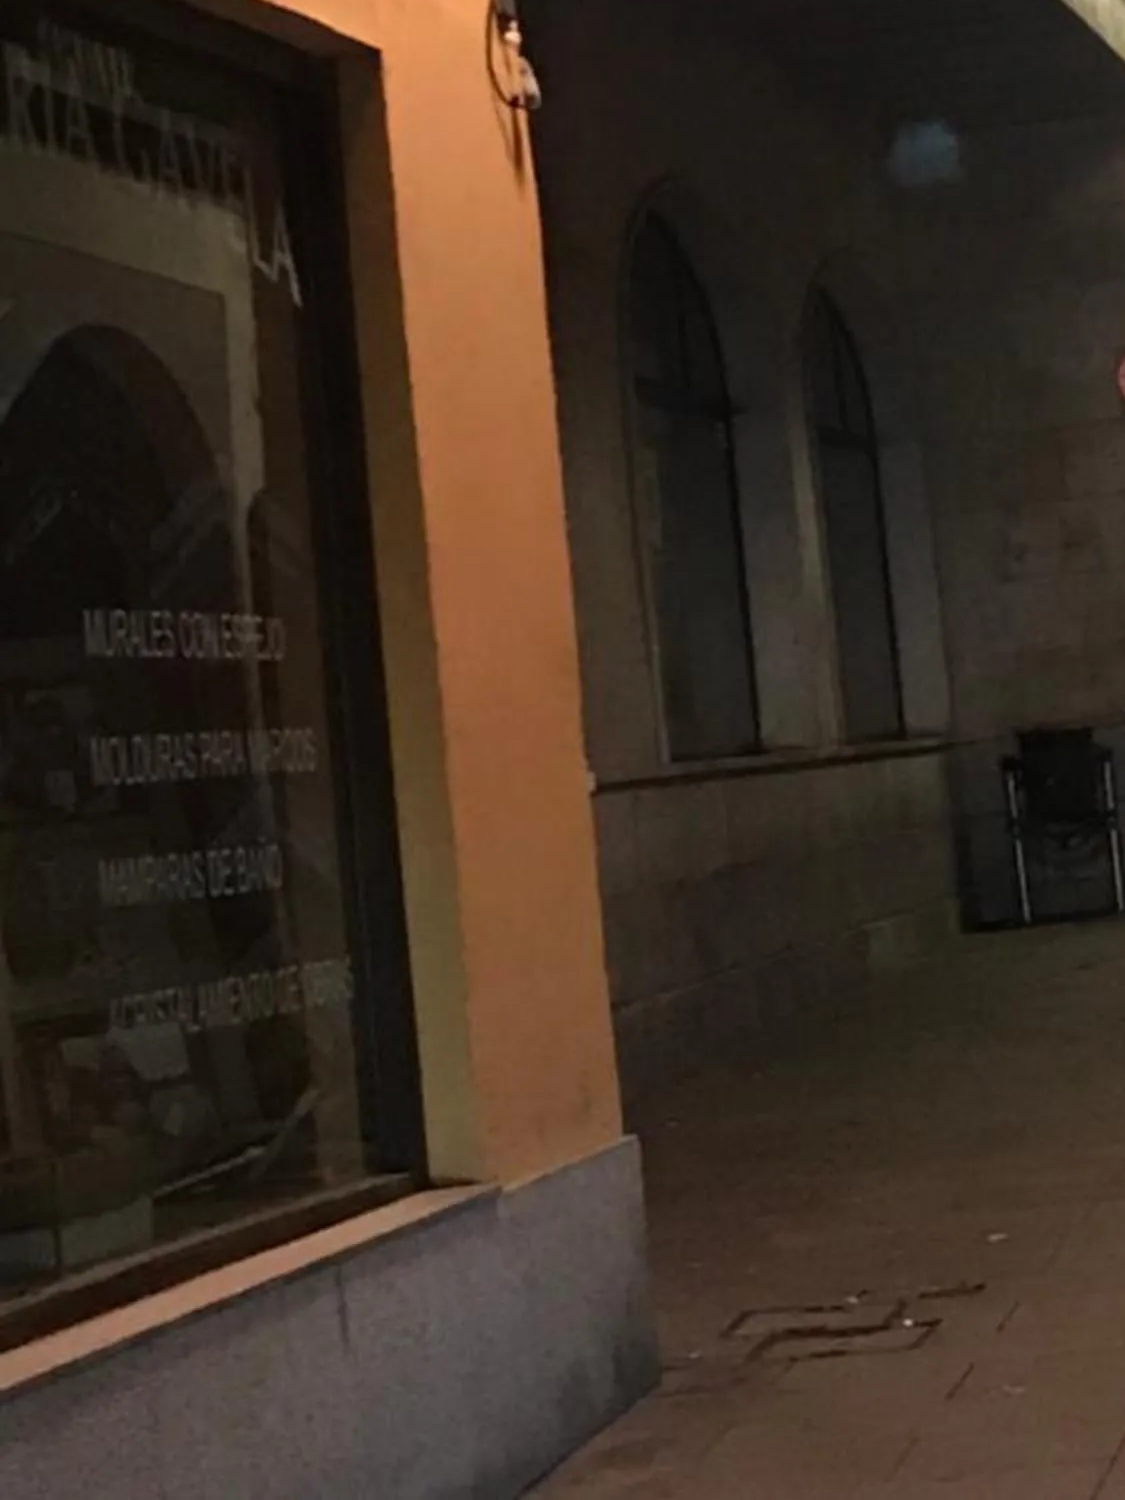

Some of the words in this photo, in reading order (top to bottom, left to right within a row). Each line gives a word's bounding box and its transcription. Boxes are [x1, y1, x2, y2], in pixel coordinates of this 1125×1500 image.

[83, 609, 175, 658] MURALES
[178, 611, 217, 659] CON
[220, 612, 288, 661] ESPEJO
[89, 732, 196, 785] MOLDURAS
[198, 729, 246, 779] PARA
[99, 851, 206, 903] MAMPARAS
[207, 847, 234, 897] DE
